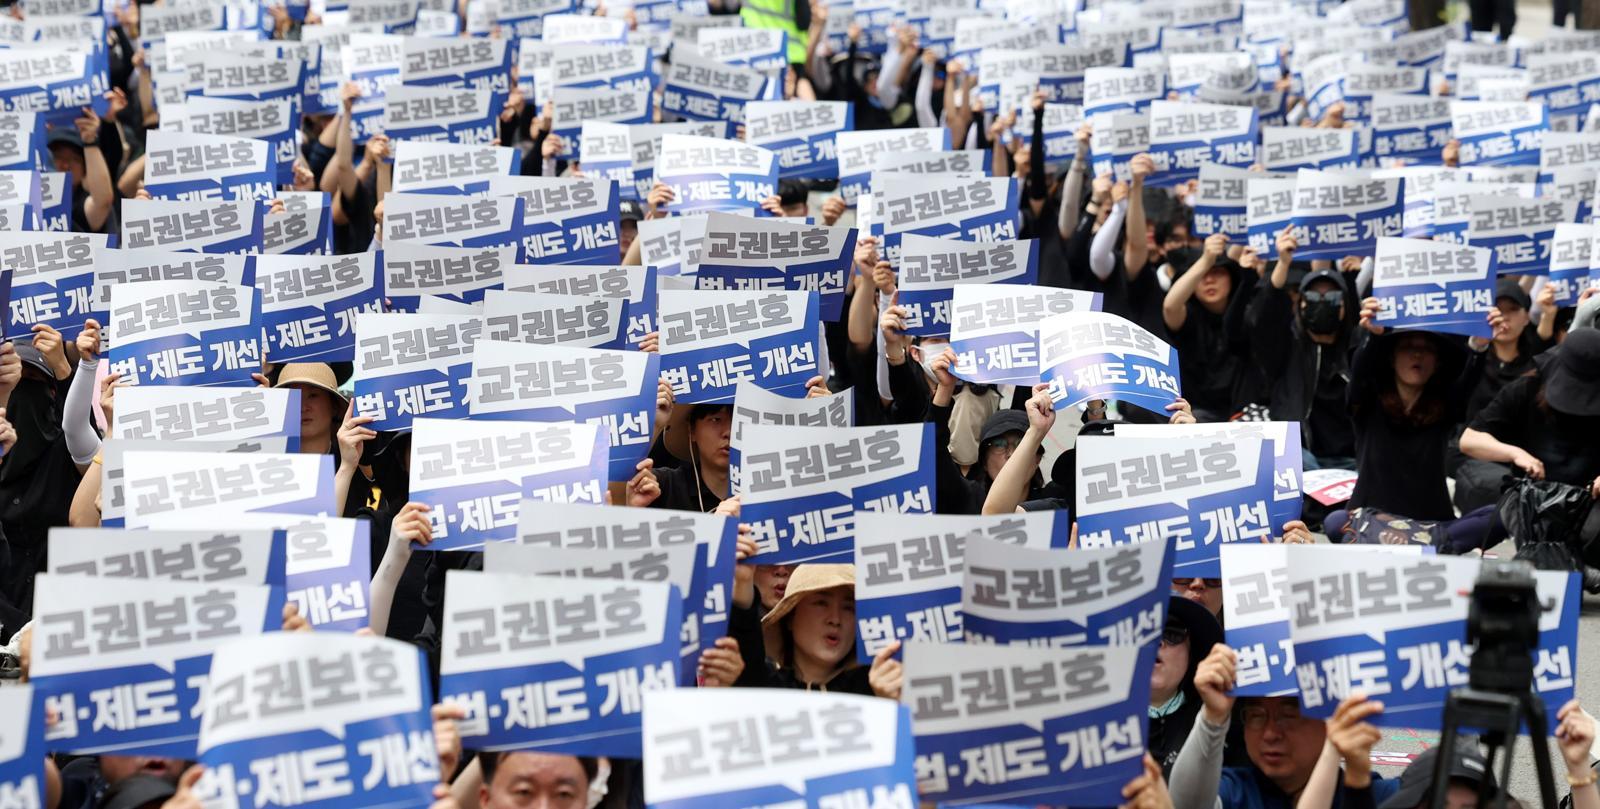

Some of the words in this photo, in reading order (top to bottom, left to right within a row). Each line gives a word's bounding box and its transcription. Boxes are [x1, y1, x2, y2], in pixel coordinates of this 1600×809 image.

[144, 14, 213, 37] 교권보호
[406, 41, 494, 74] 교권보호
[702, 32, 771, 58] 교권보호
[1043, 48, 1117, 73] 교권보호
[207, 62, 290, 89] 교권보호
[556, 49, 635, 79] 교권보호
[672, 62, 751, 94] 교권보호
[52, 84, 92, 110] 개선
[663, 92, 720, 118] 법·제도
[1087, 73, 1158, 101] 교권보호
[190, 104, 282, 135] 교권보호
[388, 92, 478, 123] 교권보호
[556, 93, 638, 123] 교권보호
[749, 104, 836, 138] 교권보호
[1155, 109, 1240, 138] 교권보호
[1376, 101, 1450, 124] 교권보호
[149, 140, 257, 177] 교권보호
[664, 146, 760, 170] 교권보호
[842, 132, 931, 169] 교권보호
[1215, 140, 1254, 163] 개선
[1266, 132, 1343, 161] 교권보호
[398, 148, 500, 185] 교권보호
[888, 181, 996, 226] 교권보호
[1297, 180, 1388, 210] 교권보호
[124, 203, 242, 249] 교권보호
[386, 199, 501, 241] 교권보호
[569, 220, 619, 252] 개선
[1473, 202, 1565, 233] 교권보호
[4, 236, 93, 278] 권보호
[708, 228, 830, 260] 교권보호
[256, 256, 364, 305] 교권보호
[386, 250, 503, 290] 교권보호
[904, 244, 1017, 283] 교권보호
[1380, 250, 1479, 280] 교권보호
[115, 286, 241, 338] 교권보호
[956, 291, 1075, 332] 교권보호
[1451, 288, 1494, 313] 개선
[486, 300, 610, 345] 교권보호
[662, 293, 793, 346] 교권보호
[209, 339, 260, 371] 개선
[758, 340, 817, 379] 개선
[477, 353, 628, 404] 교권보호
[119, 391, 270, 441] 교권보호
[417, 427, 576, 480] 교권보호
[746, 429, 905, 493] 교권보호
[130, 458, 301, 516] 교권보호
[1081, 441, 1242, 505] 교권보호
[1200, 500, 1271, 545] 개선
[969, 548, 1144, 610] 교권보호
[1290, 560, 1452, 629] 교권보호
[42, 590, 242, 660] 교권보호
[453, 586, 647, 659] 교권보호
[210, 646, 404, 729] 교권보호
[909, 651, 1111, 722] 교권보호
[654, 702, 873, 782] 교권보호
[1056, 714, 1145, 773] 개선
